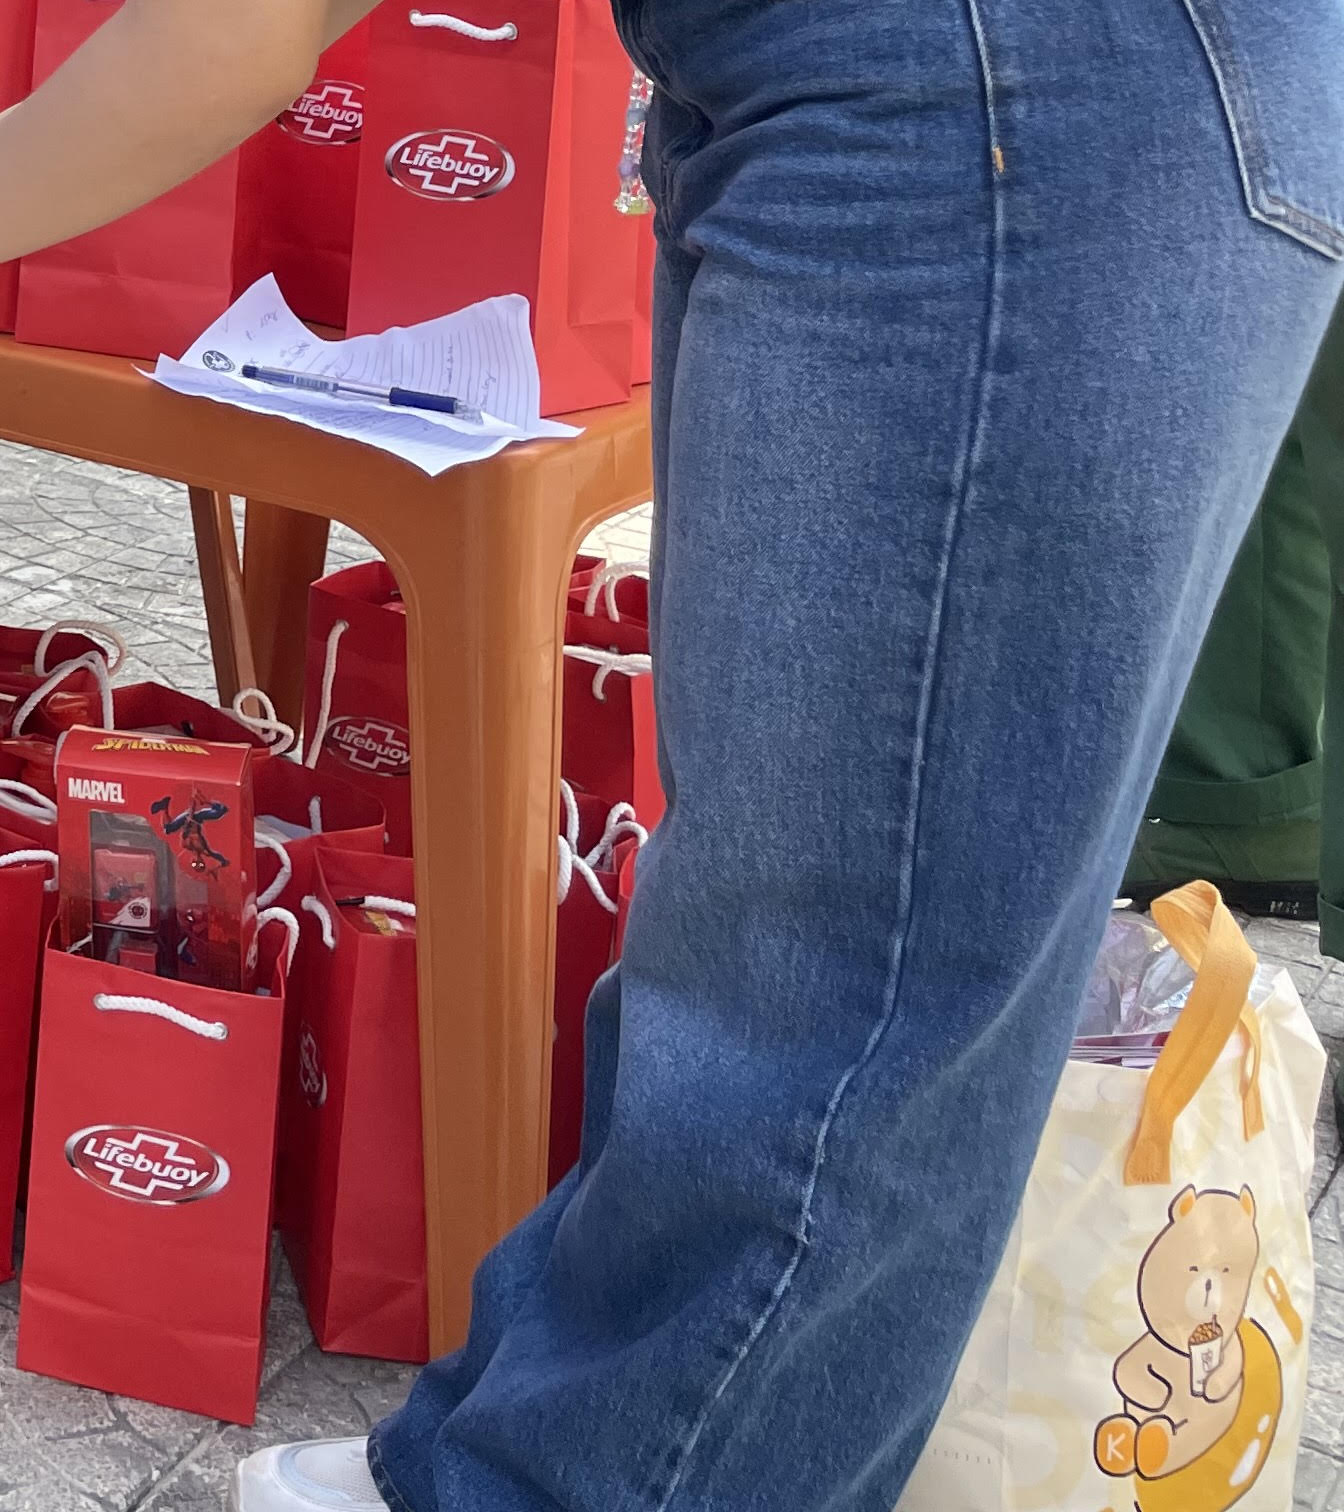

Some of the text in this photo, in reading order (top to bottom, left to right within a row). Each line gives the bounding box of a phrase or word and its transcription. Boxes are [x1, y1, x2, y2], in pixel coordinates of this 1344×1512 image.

[399, 147, 501, 184] Lifebuoy
[67, 777, 126, 804] MARVEL
[82, 1137, 210, 1188] Lifebuoy
[1106, 1432, 1127, 1463] K
